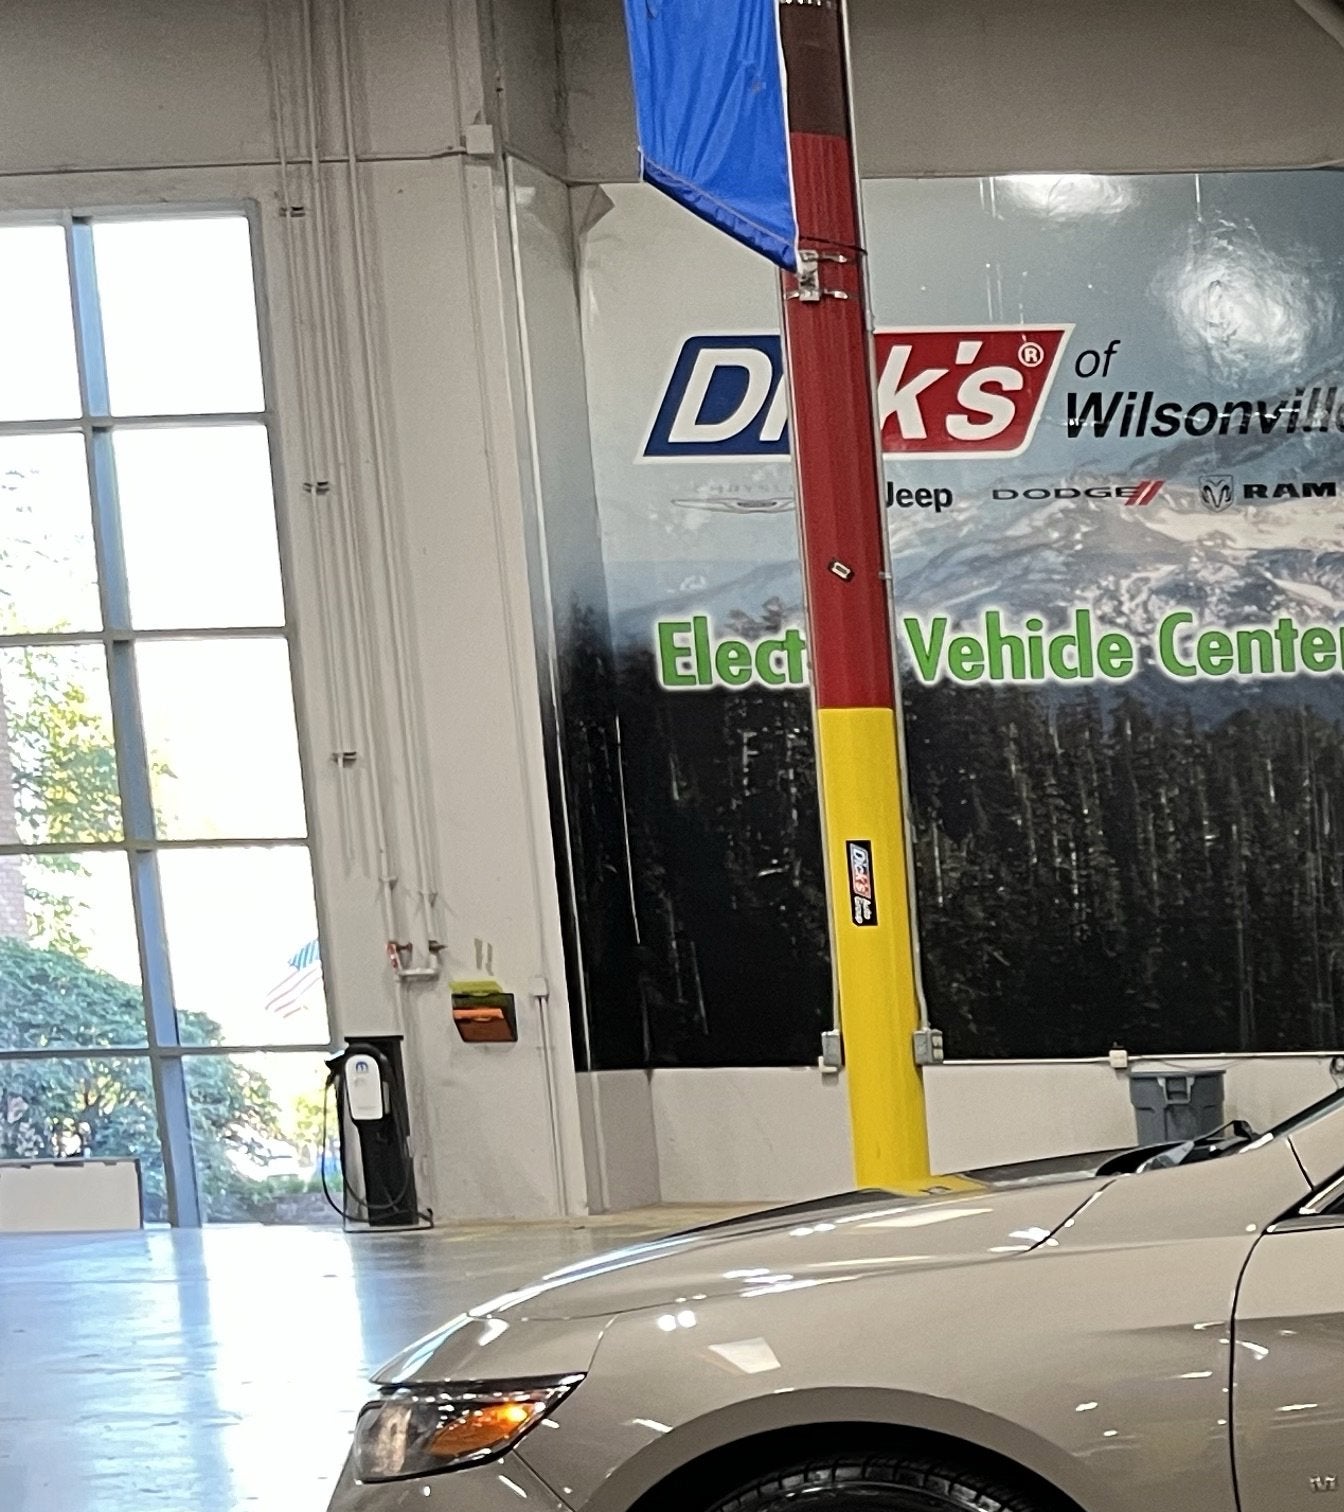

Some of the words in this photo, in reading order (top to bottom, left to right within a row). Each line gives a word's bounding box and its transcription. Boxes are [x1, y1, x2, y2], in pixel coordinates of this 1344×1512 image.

[1075, 340, 1120, 377] of
[886, 480, 953, 512] Jeep
[992, 486, 1139, 501] DODGE
[1243, 482, 1337, 499] RAM
[903, 608, 1134, 681] Vehicle
